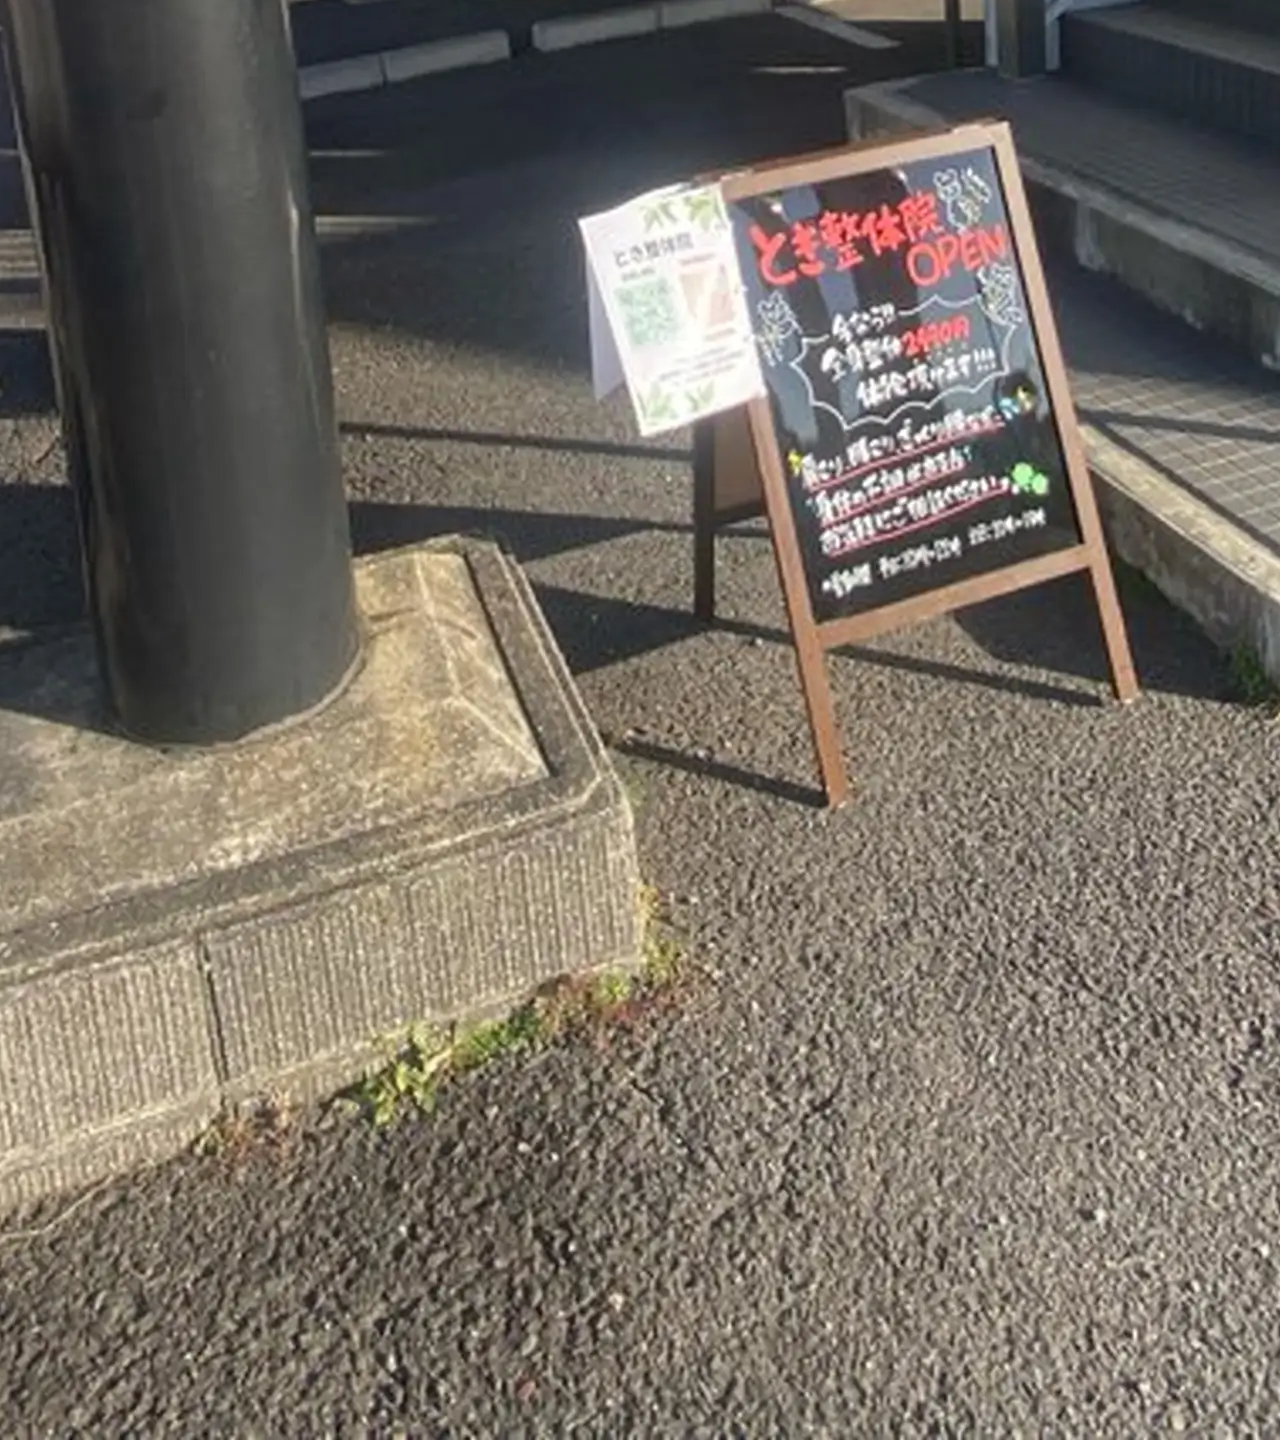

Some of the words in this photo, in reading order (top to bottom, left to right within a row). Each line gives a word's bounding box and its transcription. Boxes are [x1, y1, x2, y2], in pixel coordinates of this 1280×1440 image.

[748, 190, 945, 285] とき整体院
[906, 224, 1008, 287] OPEN
